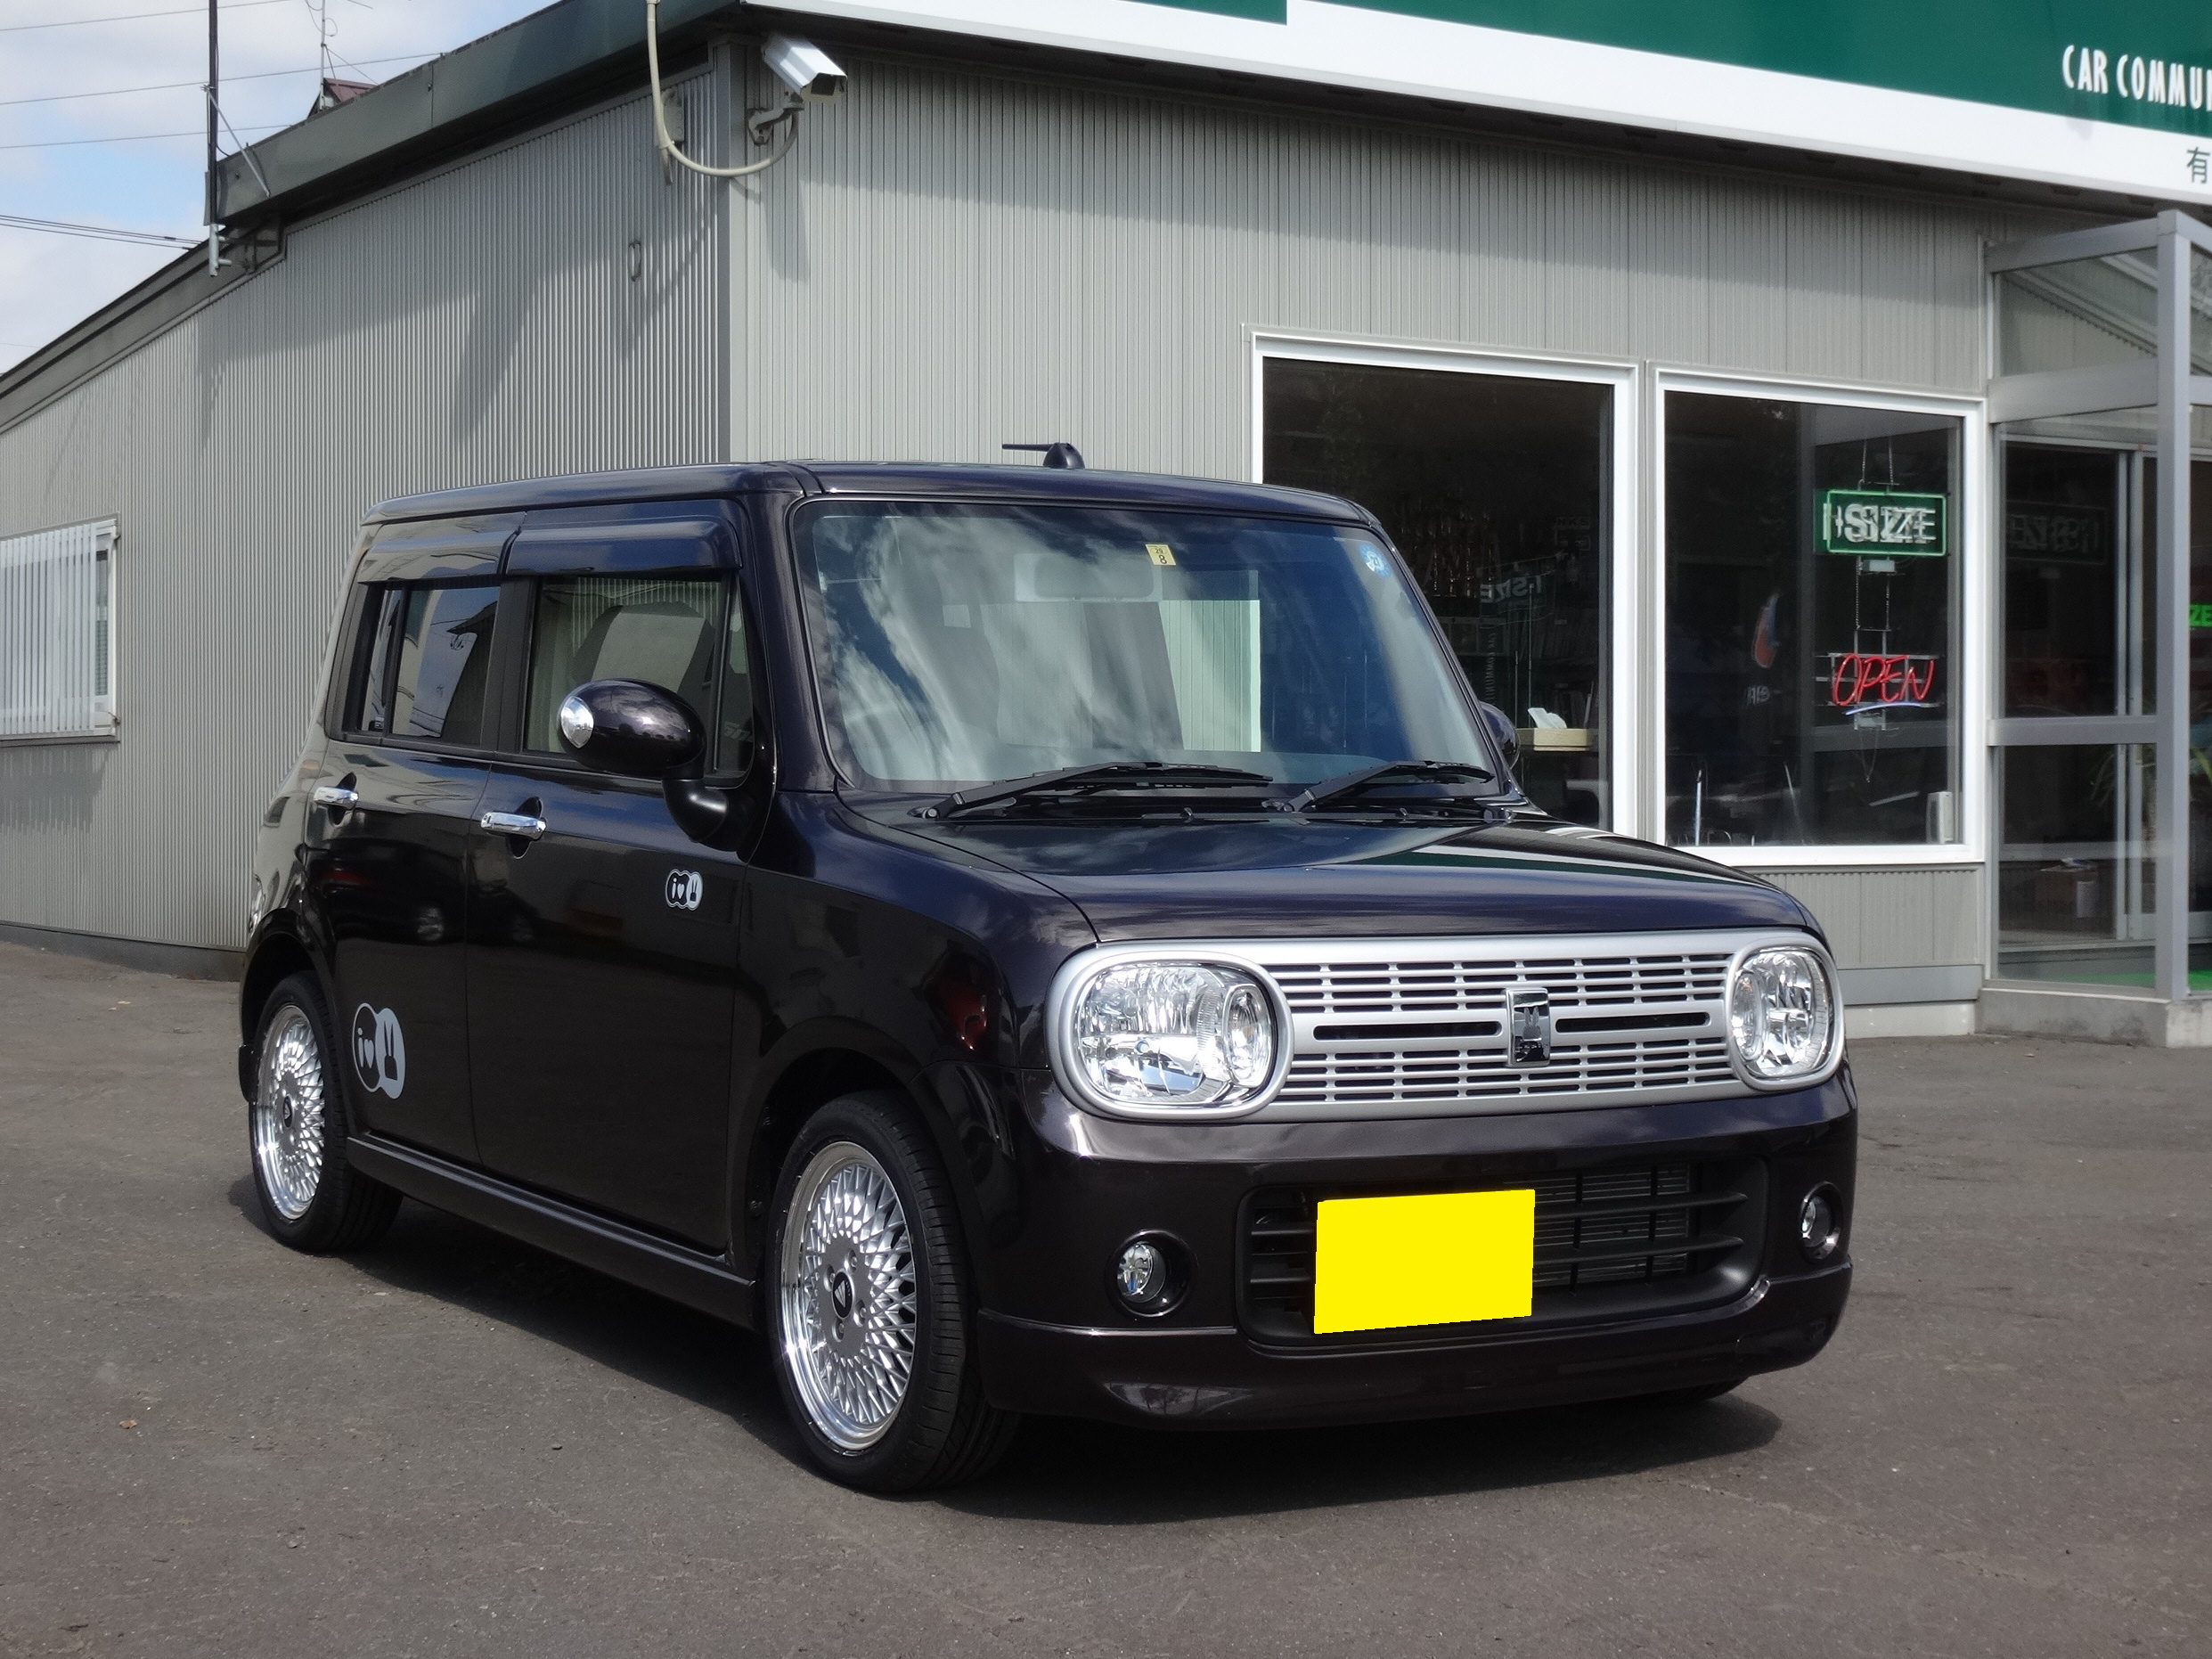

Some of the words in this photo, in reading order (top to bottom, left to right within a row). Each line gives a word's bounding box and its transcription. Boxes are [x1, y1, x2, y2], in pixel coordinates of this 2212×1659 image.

[2061, 45, 2109, 94] CAR
[2186, 147, 2211, 184] 有
[1158, 554, 1168, 565] 8
[1831, 653, 1935, 707] OPEN
